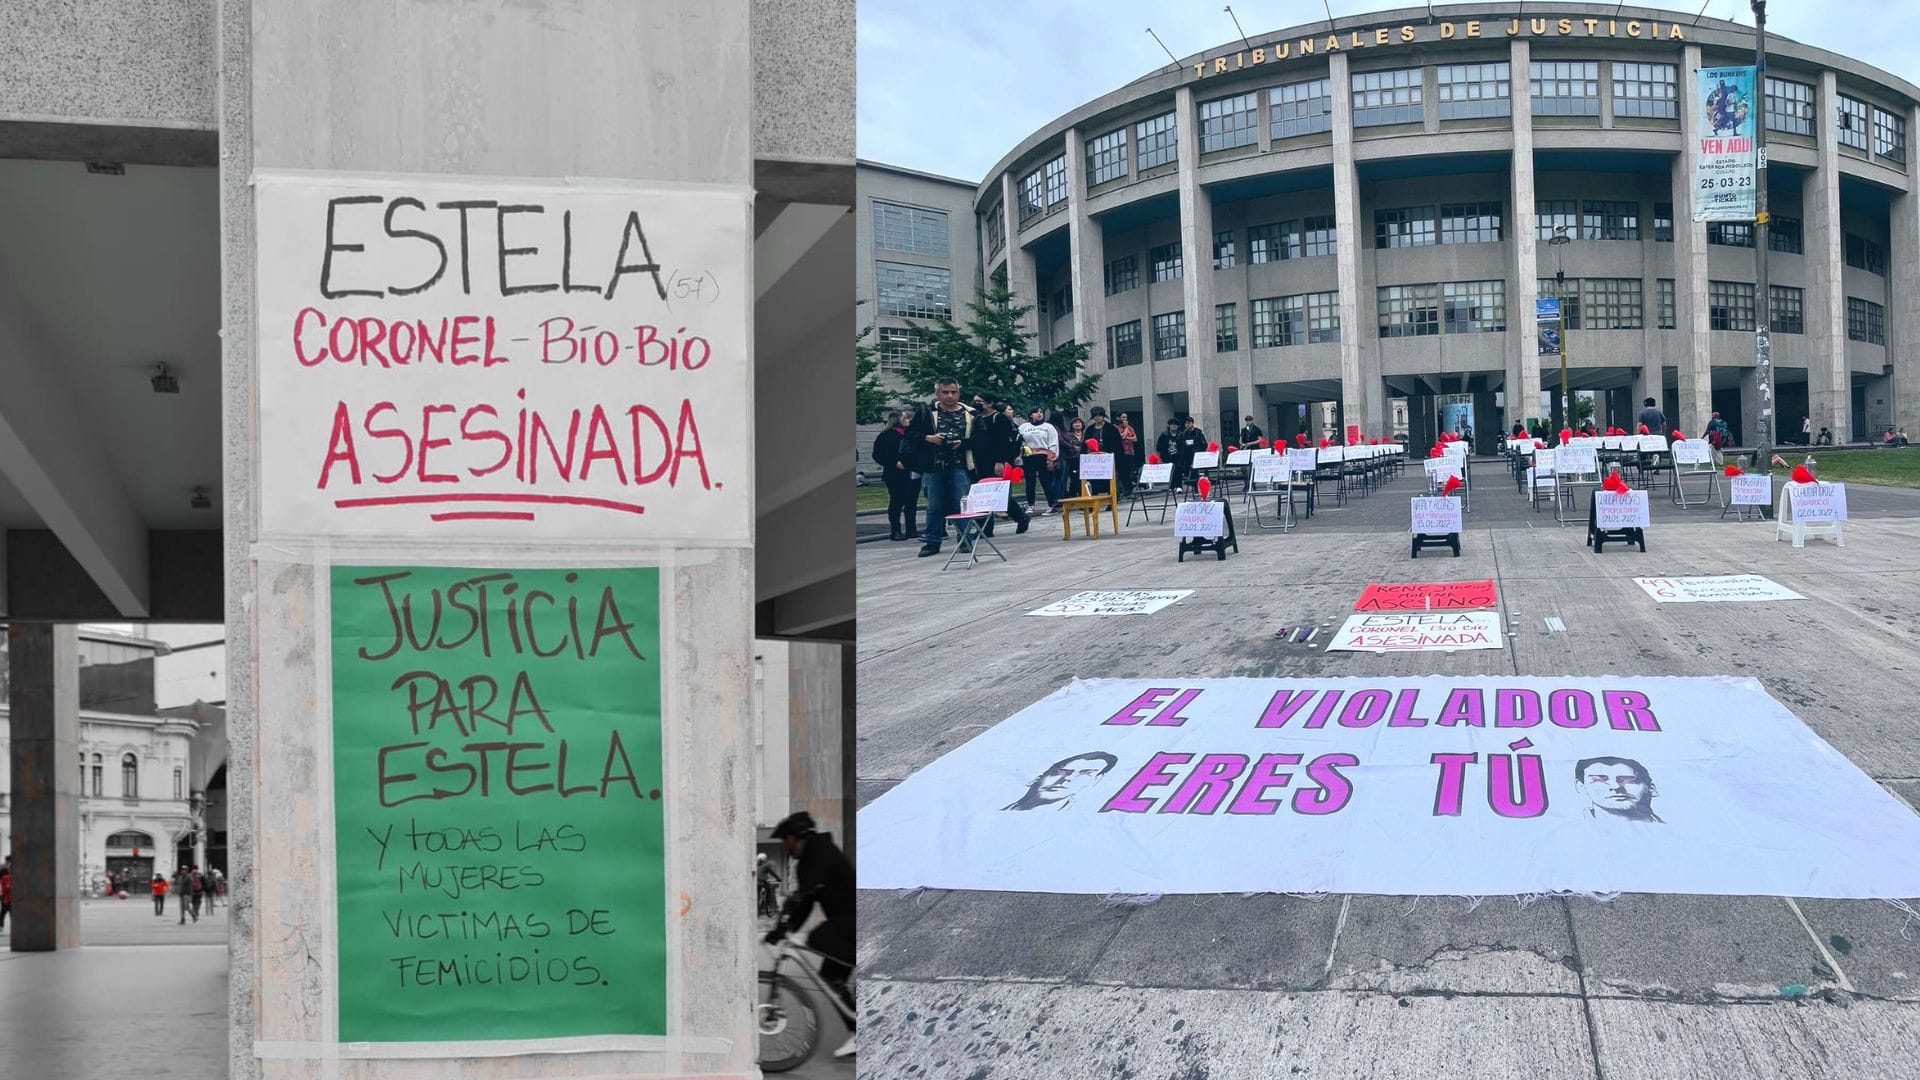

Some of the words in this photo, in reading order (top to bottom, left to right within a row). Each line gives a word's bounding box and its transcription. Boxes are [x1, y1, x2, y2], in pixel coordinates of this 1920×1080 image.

[1194, 25, 1416, 78] TRIBUNALES
[1440, 20, 1480, 39] DE
[1506, 18, 1684, 39] JUSTICIA
[1701, 139, 1723, 154] VEN
[320, 195, 667, 301] ESTELA
[294, 306, 509, 368] CORONEL
[1793, 487, 1817, 498] CLAUDIA
[1349, 625, 1419, 634] CORONEL
[1362, 614, 1473, 626] ESTELA
[391, 670, 555, 737] PARA
[1100, 687, 1204, 728] EL
[1254, 687, 1663, 732] VIOLADOR
[377, 730, 662, 808] ESTELA.
[1097, 751, 1361, 816] ERES
[1430, 736, 1550, 819] TÚ
[516, 819, 586, 852] LAS
[399, 861, 545, 900] MUJERES
[566, 909, 617, 937] DE
